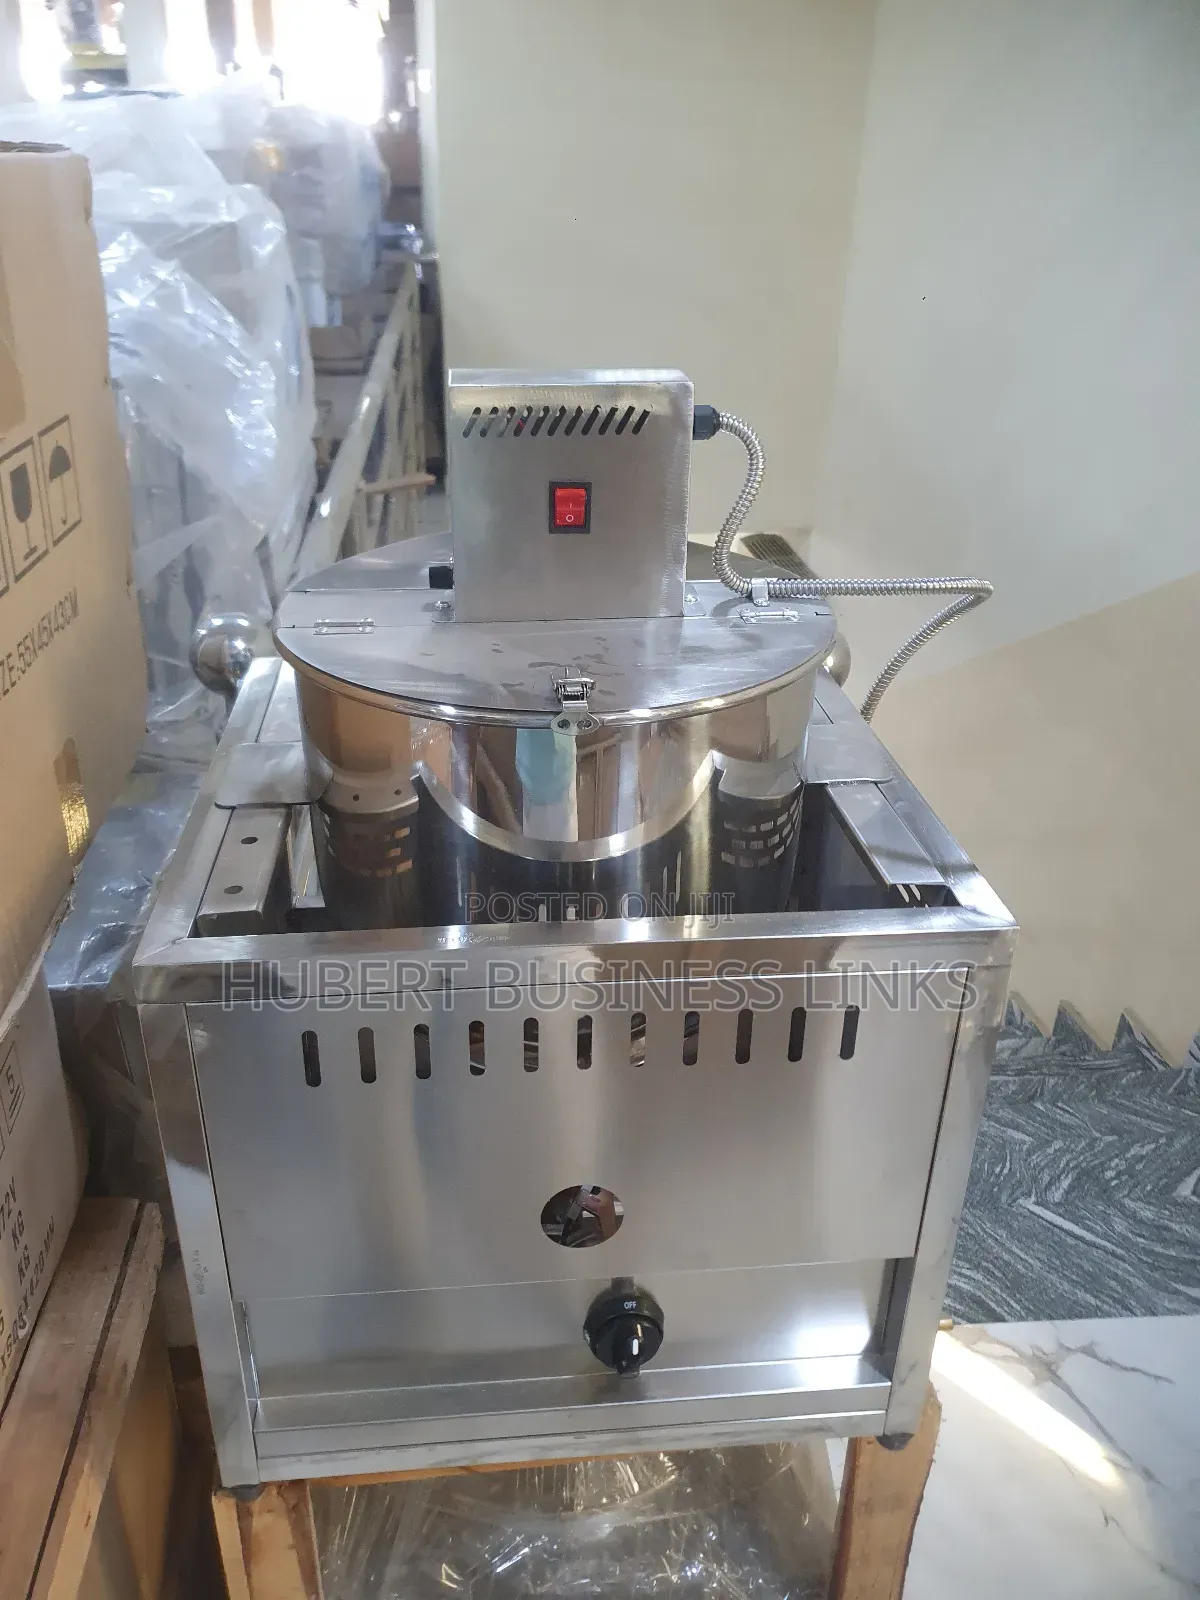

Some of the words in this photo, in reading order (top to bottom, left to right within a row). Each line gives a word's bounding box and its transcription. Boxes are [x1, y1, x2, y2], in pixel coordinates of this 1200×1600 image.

[11, 1208, 25, 1252] KG
[17, 1244, 31, 1286] KG
[623, 1300, 637, 1310] OFF
